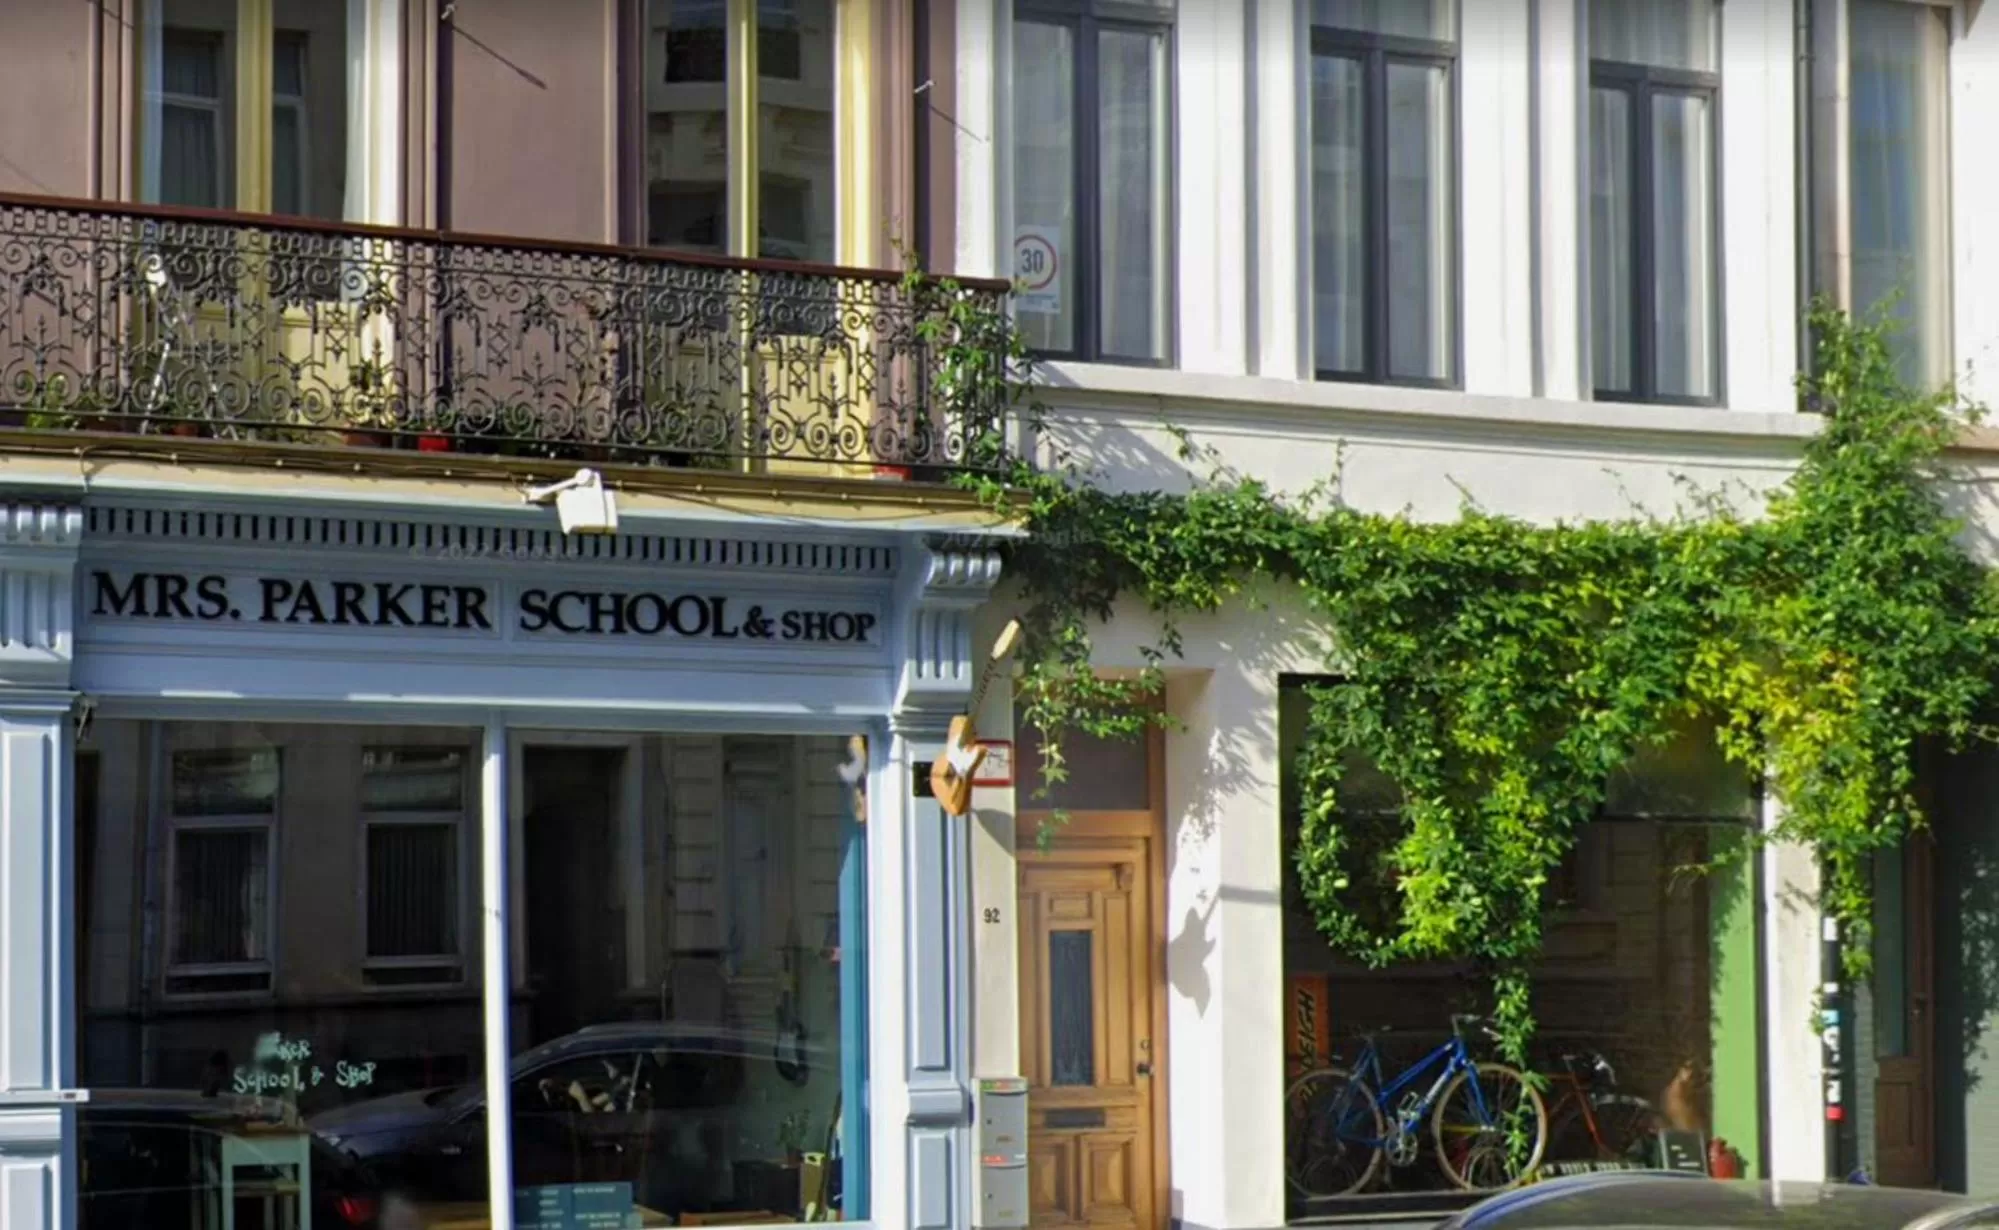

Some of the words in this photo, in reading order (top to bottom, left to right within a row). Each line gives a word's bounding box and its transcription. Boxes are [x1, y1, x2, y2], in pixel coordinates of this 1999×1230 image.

[1021, 248, 1045, 274] 30
[91, 570, 241, 623] MRS.
[257, 577, 493, 629] PARKER
[518, 588, 740, 640] SCHOOL
[742, 604, 776, 640] &
[781, 610, 876, 643] SHOP
[983, 907, 1001, 924] 92
